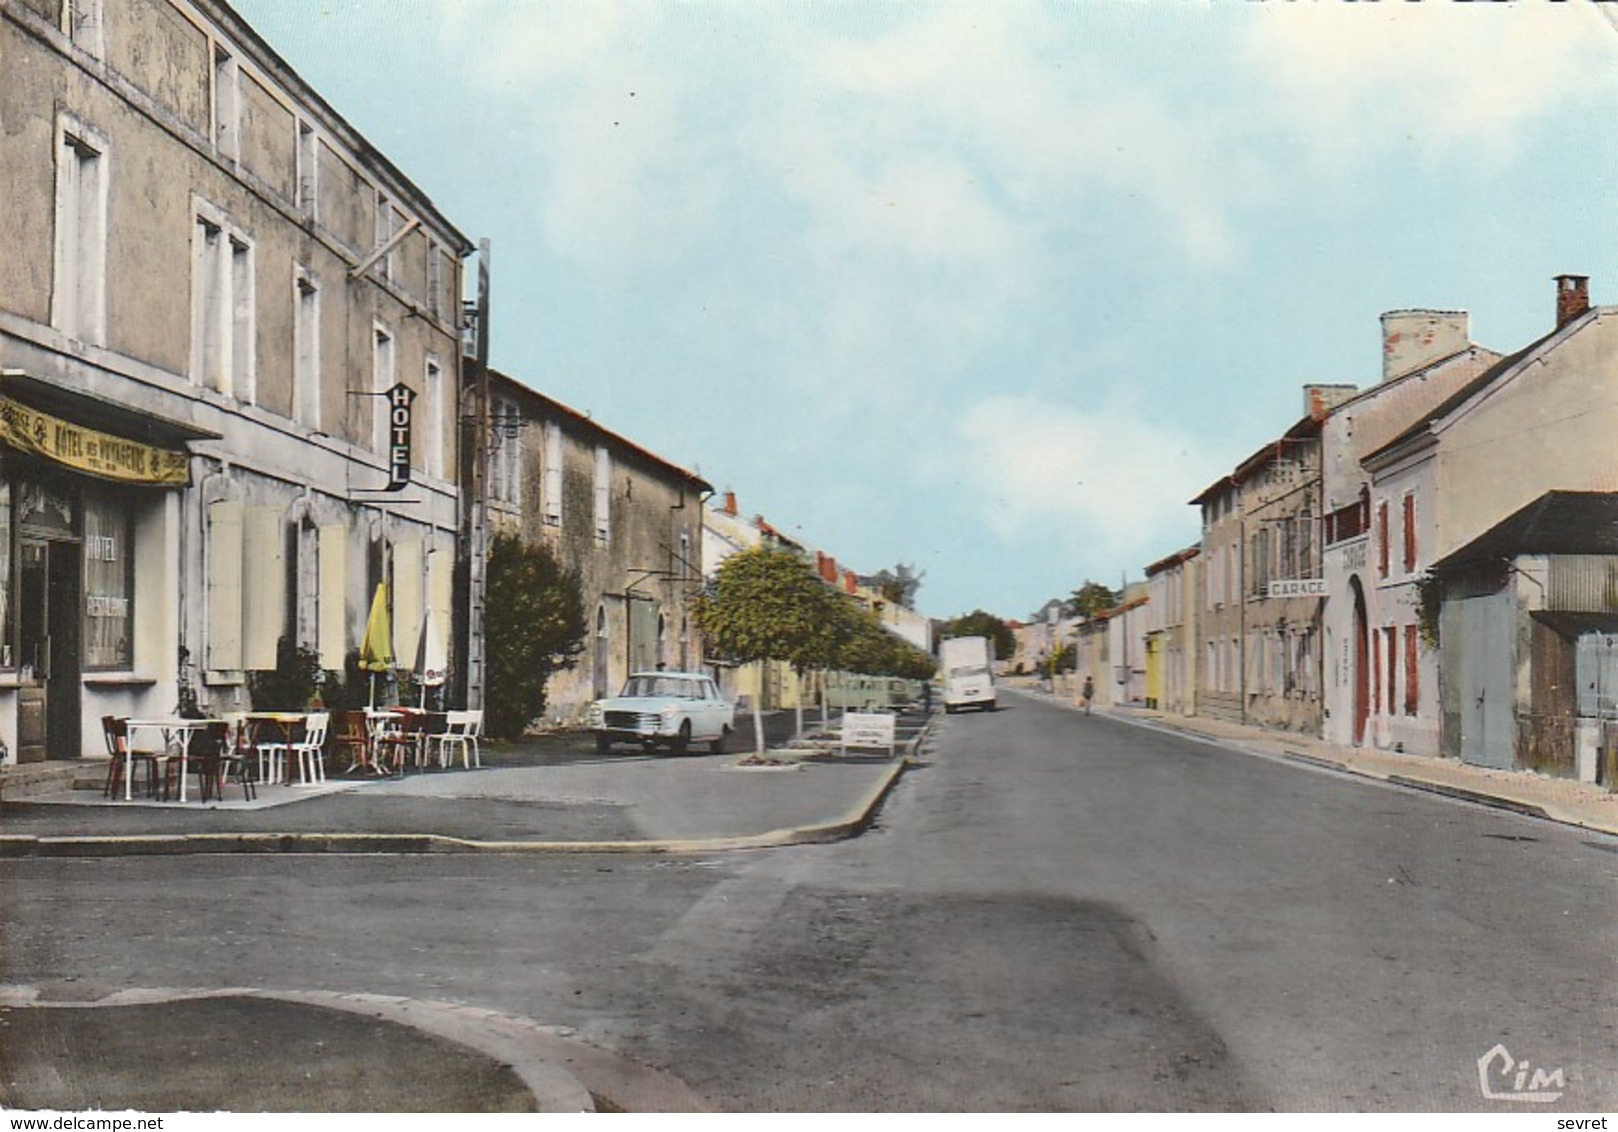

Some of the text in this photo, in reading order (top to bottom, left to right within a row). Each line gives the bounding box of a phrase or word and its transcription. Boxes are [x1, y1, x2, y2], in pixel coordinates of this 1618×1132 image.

[54, 423, 83, 458] HOTEL
[99, 438, 145, 475] VOYAGEURS
[393, 388, 409, 483] HOTEL
[86, 535, 117, 562] HOTEL
[1271, 581, 1326, 596] GARAGE
